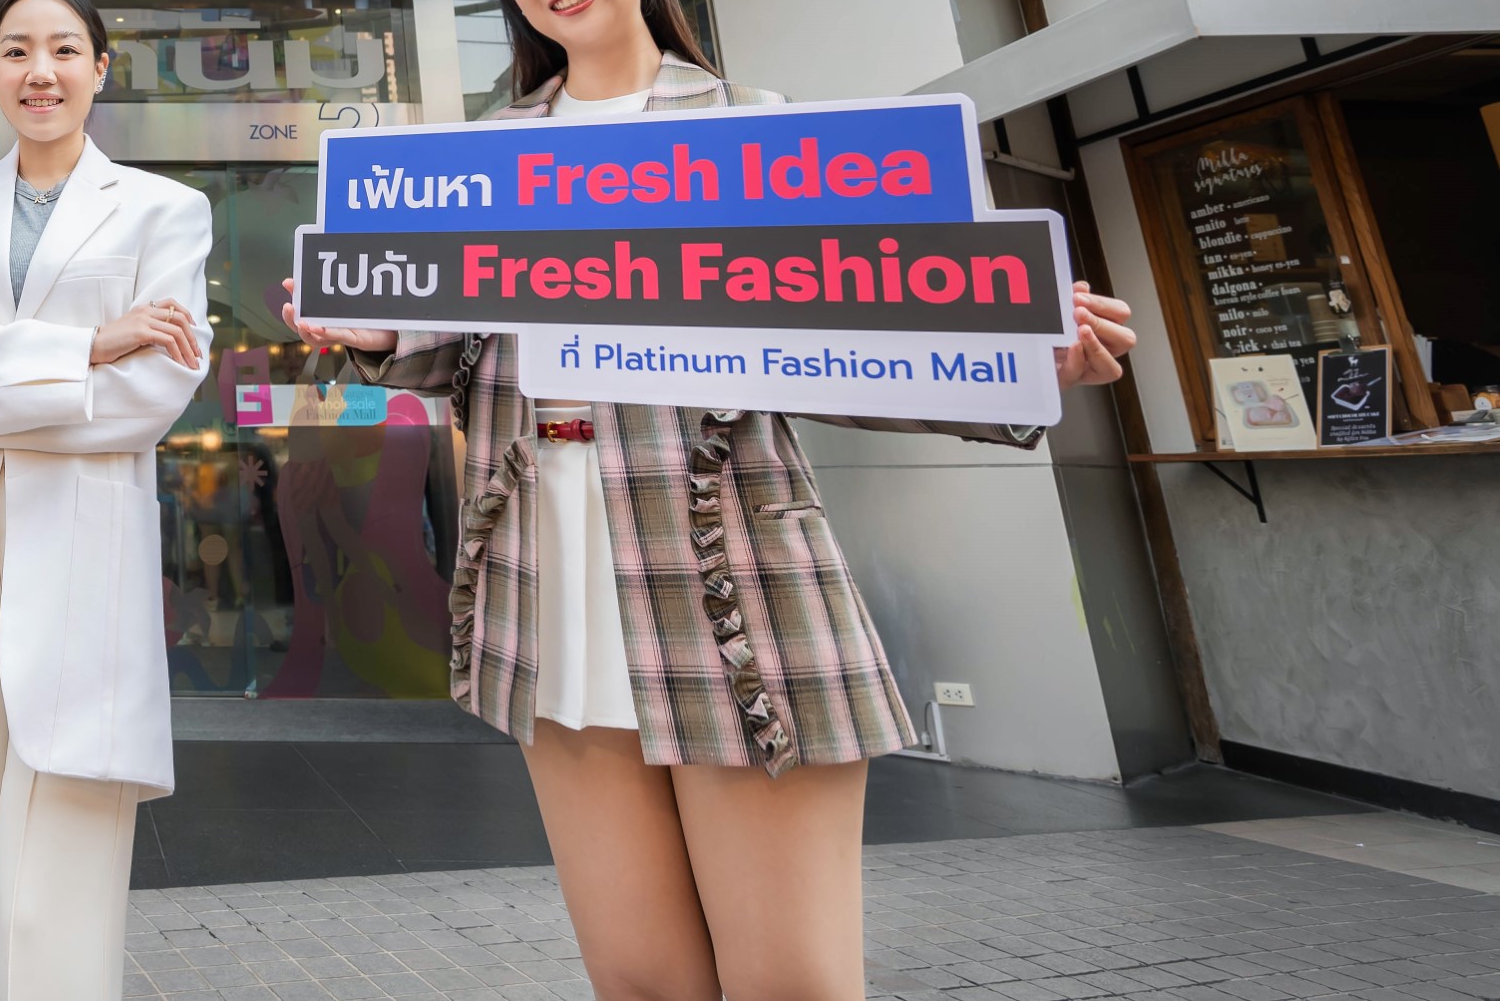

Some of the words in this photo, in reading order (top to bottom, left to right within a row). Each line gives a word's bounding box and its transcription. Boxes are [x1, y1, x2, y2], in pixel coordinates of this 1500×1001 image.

[249, 124, 298, 140] ZONE
[346, 164, 493, 210] เฟ้นหา
[516, 141, 721, 207] Fresh
[741, 136, 934, 202] Idea
[1190, 202, 1225, 219] amber
[1198, 231, 1243, 250] blondie
[1203, 253, 1223, 265] tan
[317, 250, 440, 300] ไปกับ
[461, 240, 660, 301] Fresh
[679, 237, 1032, 306] Fashion
[1207, 264, 1244, 280] mikka
[1211, 280, 1257, 297] dalgona
[1213, 296, 1239, 306] korean
[1257, 290, 1280, 300] coffee
[1280, 286, 1301, 296] foam
[1218, 307, 1245, 322] milo
[1251, 308, 1269, 318] milo
[1222, 325, 1247, 338] noir
[560, 333, 582, 370] ที่
[593, 342, 748, 377] Platinum
[762, 346, 913, 382] Fashion
[931, 350, 1019, 385] Mall
[309, 397, 376, 409] Wholesale
[306, 409, 349, 420] Fashion
[353, 408, 376, 420] Mall
